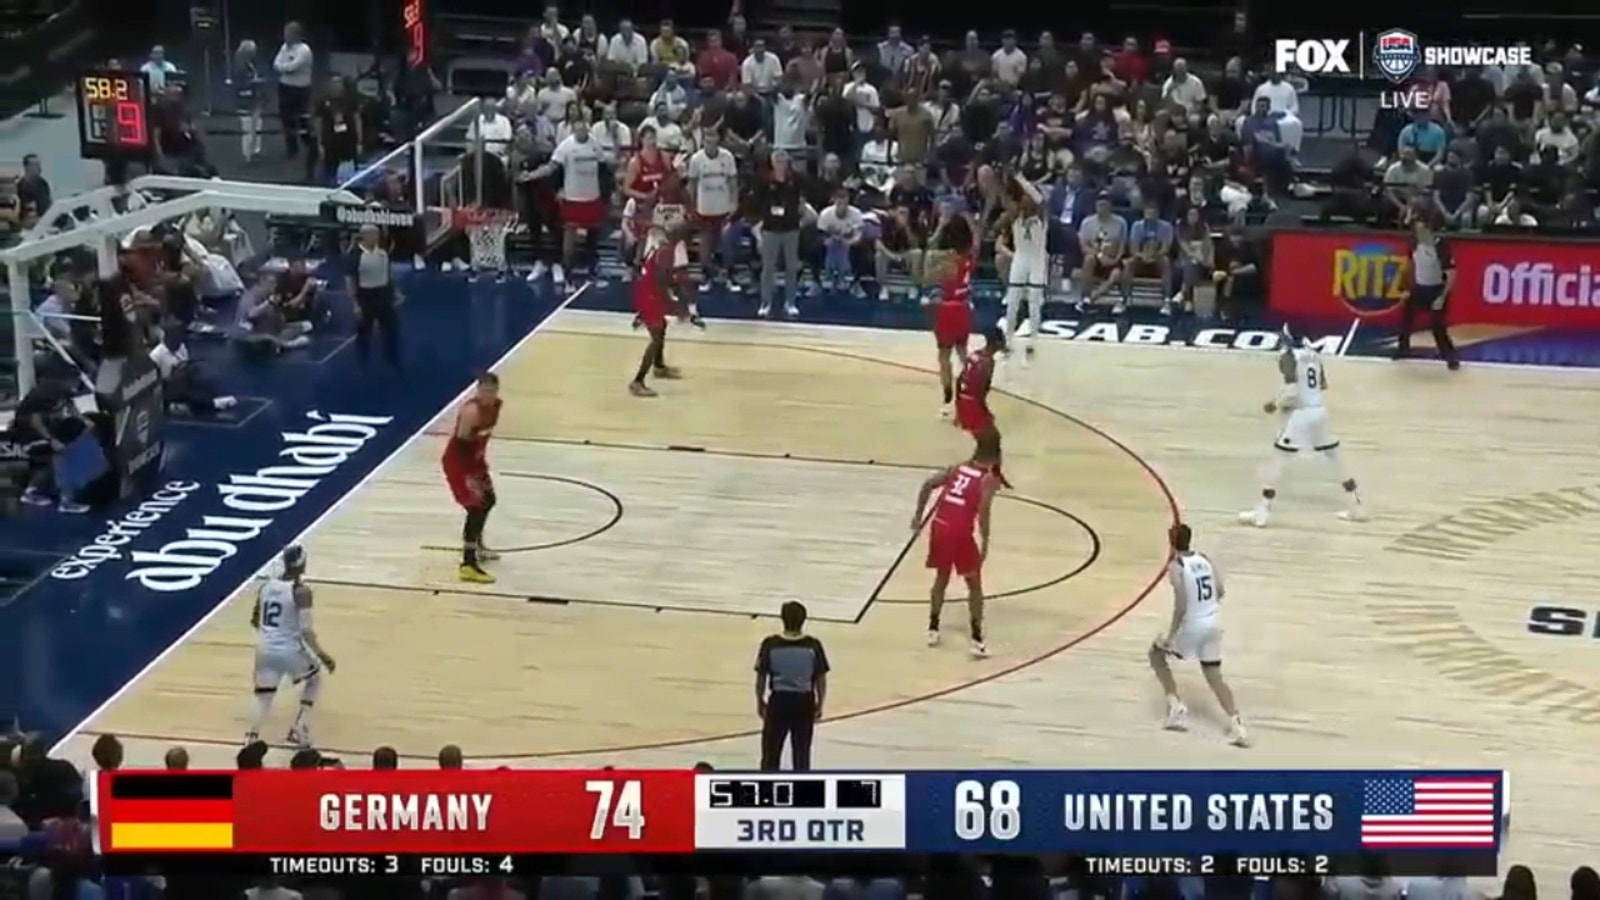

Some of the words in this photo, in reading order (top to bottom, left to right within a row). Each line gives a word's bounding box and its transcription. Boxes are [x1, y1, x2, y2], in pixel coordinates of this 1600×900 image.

[85, 77, 128, 101] 58.2
[117, 103, 147, 145] 9
[1333, 249, 1411, 300] RITZ
[1306, 367, 1317, 389] 8
[51, 479, 200, 581] experience
[125, 515, 274, 591] abu
[1196, 575, 1213, 602] 15
[263, 601, 283, 628] 12
